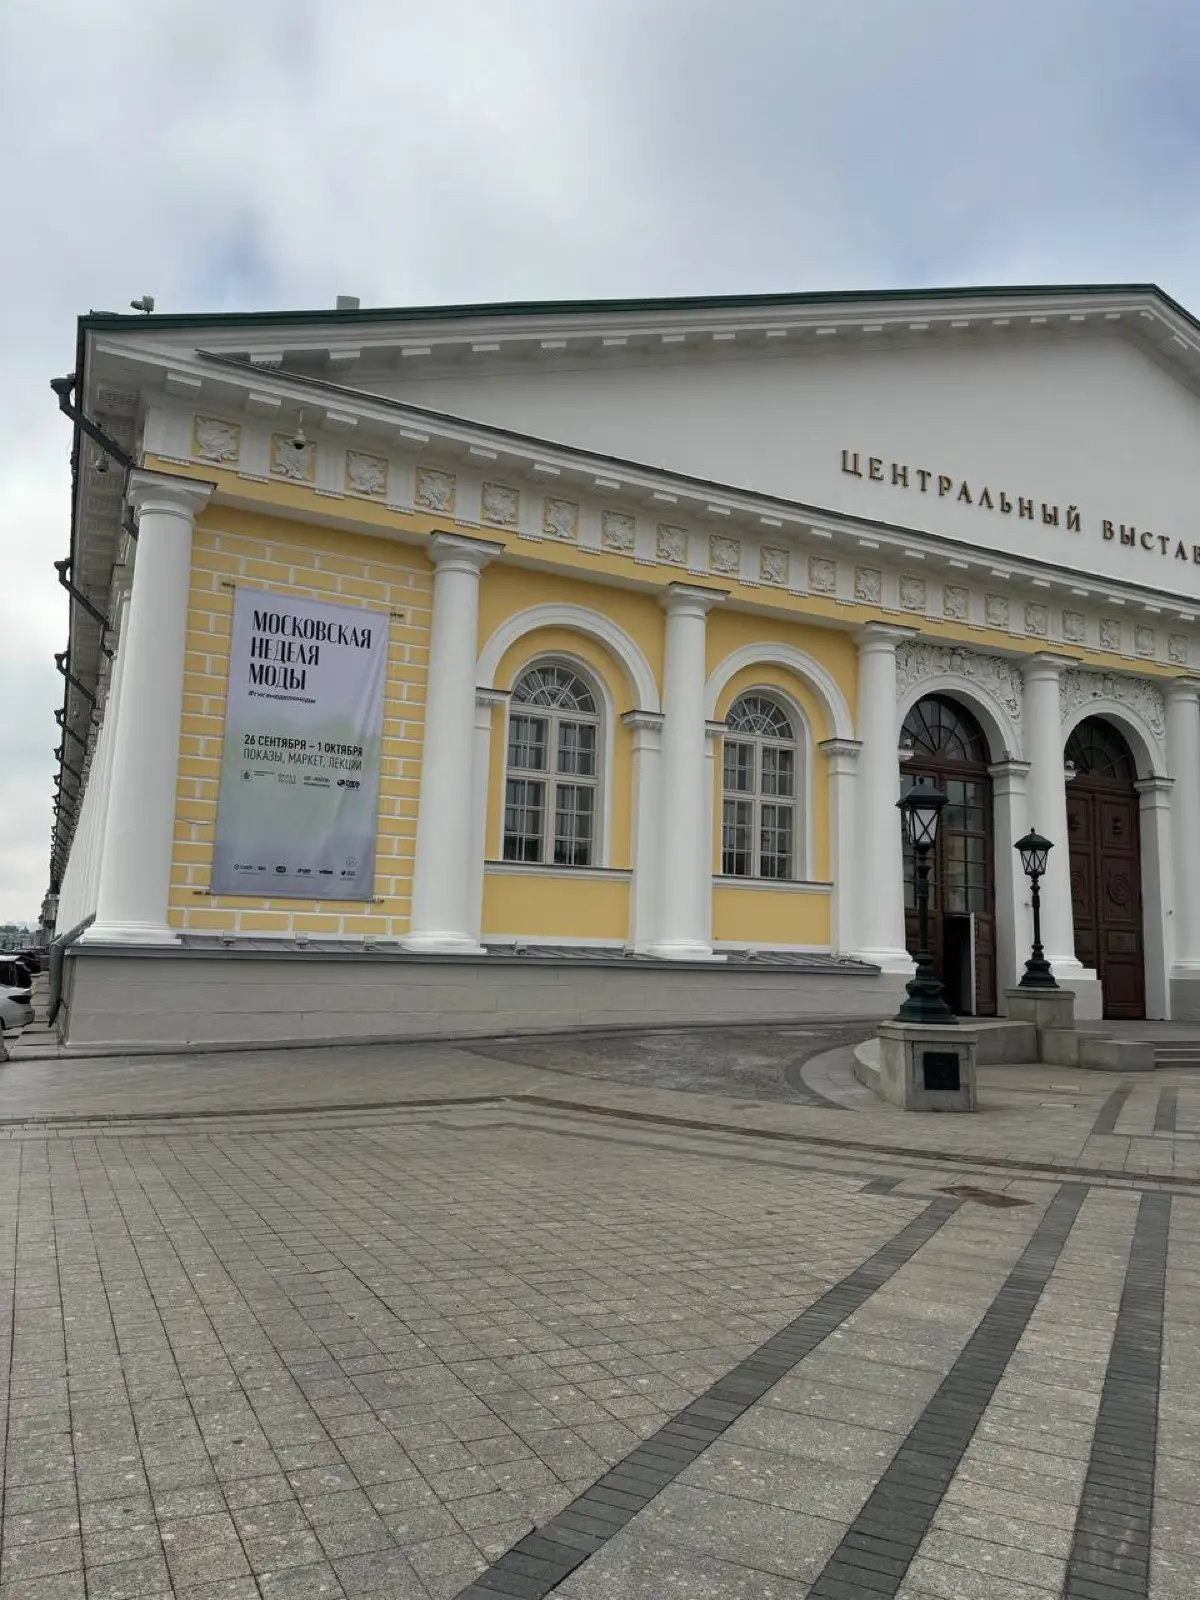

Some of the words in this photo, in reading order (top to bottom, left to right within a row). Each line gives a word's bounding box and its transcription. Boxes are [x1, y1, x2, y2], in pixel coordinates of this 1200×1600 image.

[840, 449, 1082, 532] ЦЕНТРАЛЬНЫЙ
[252, 610, 371, 649] МОСКОВСКАЯ
[250, 637, 320, 666] НЕДЕЛЯ
[248, 663, 306, 690] МОДЫ
[243, 748, 285, 764] ПОКАЗЫ,
[288, 753, 326, 768] МАРКЕТ,
[328, 756, 362, 771] ЛЕКЦИИ
[244, 734, 256, 745] 26
[258, 735, 306, 750] СЕНТЯБРЯ
[317, 742, 322, 751] 1
[324, 743, 363, 757] ОКТЯБРЯ
